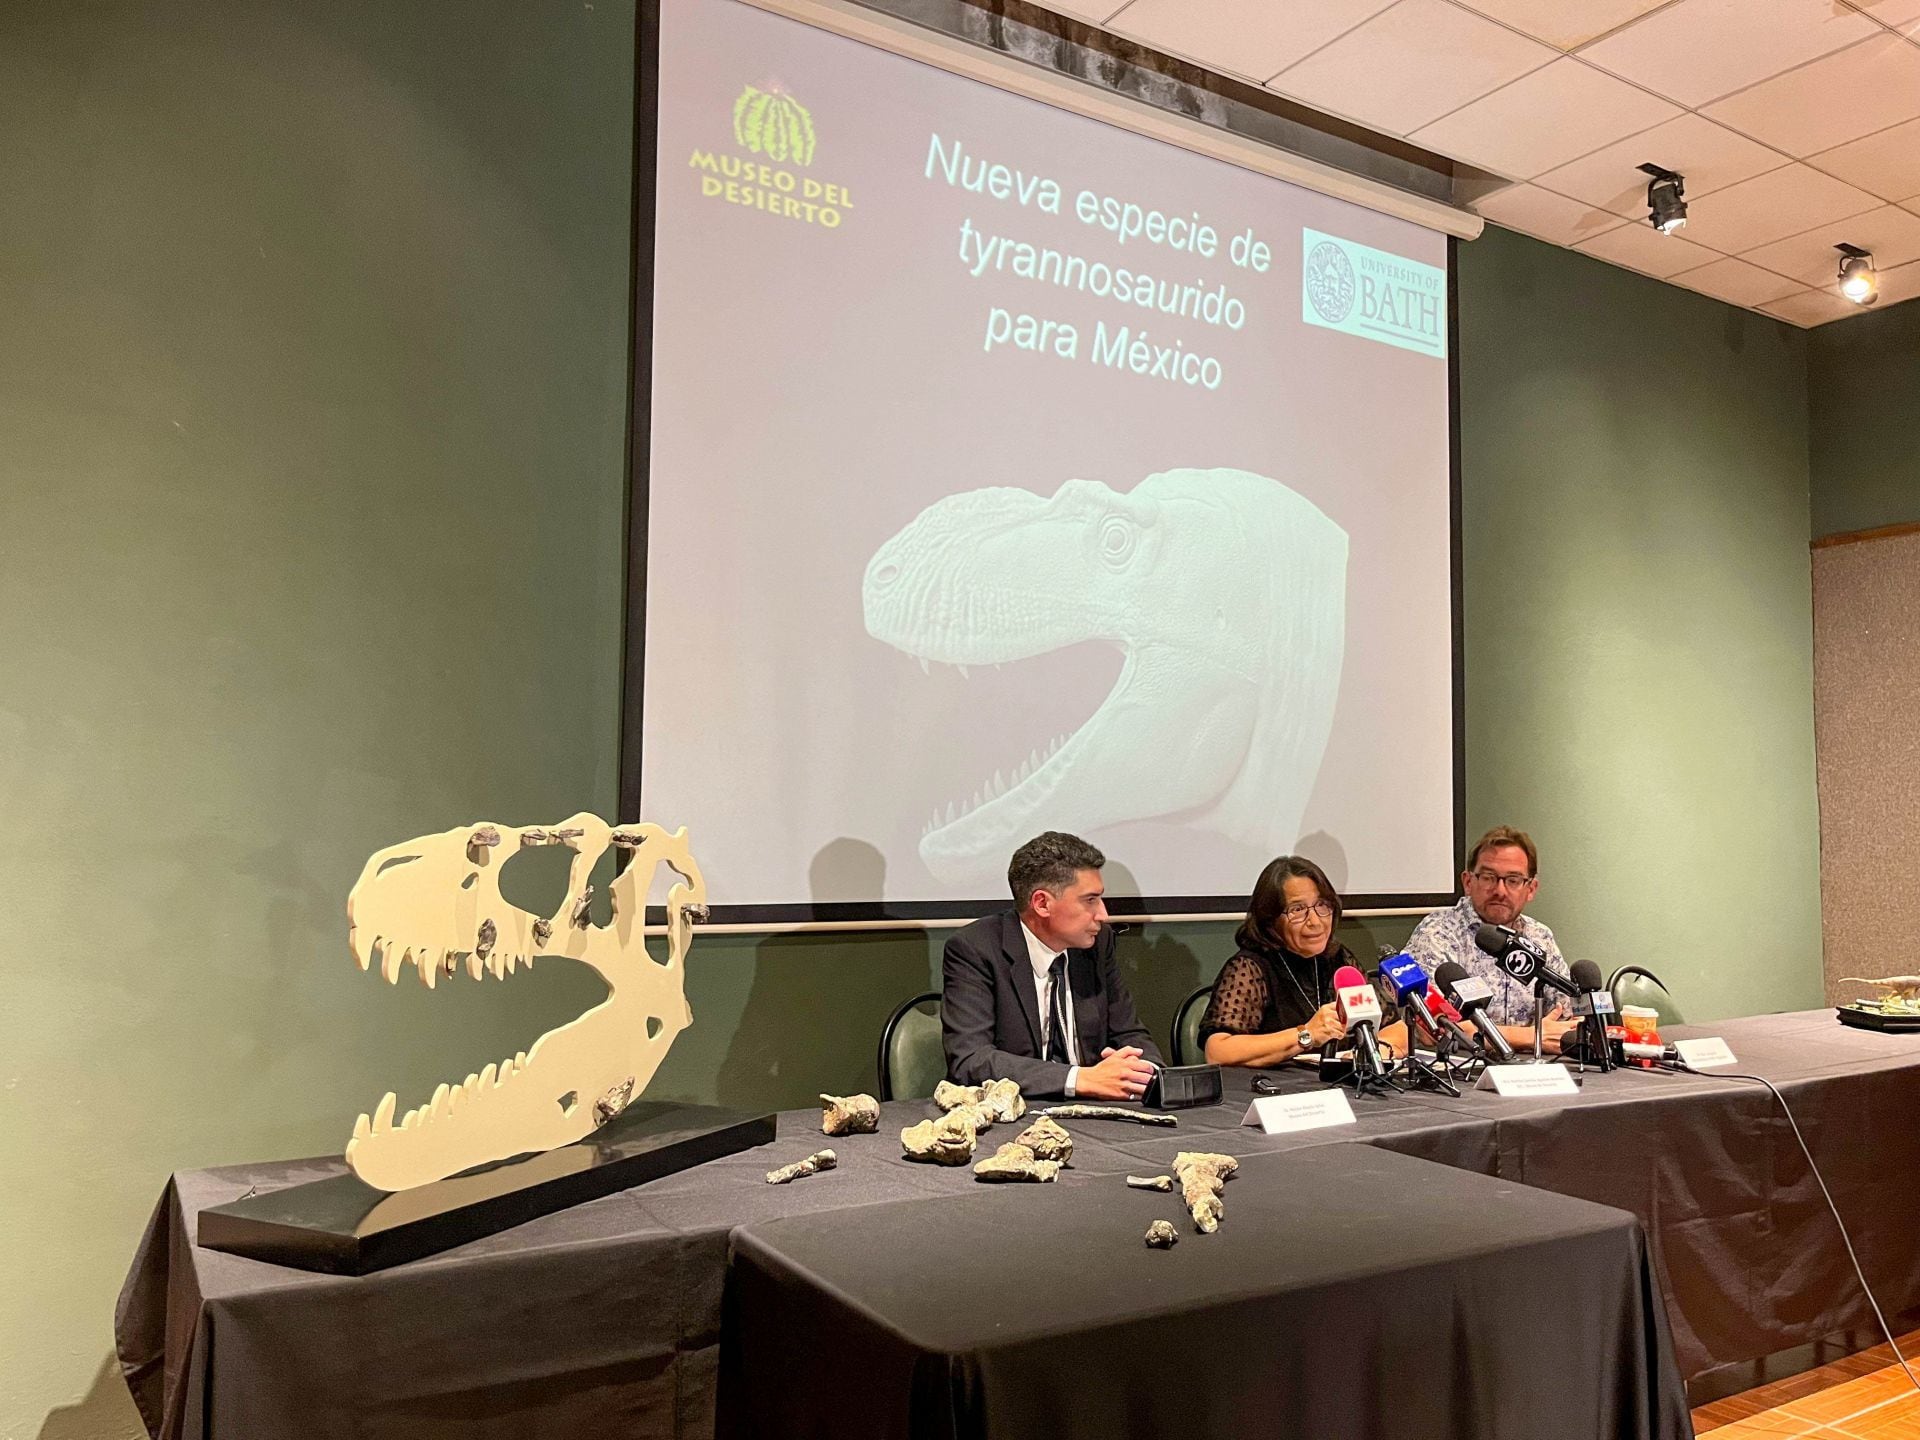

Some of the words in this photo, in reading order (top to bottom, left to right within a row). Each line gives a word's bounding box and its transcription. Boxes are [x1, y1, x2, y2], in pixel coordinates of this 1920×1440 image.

[689, 148, 796, 192] MUSEO
[803, 177, 854, 208] DEL
[702, 175, 841, 228] DESIERTO
[925, 132, 1061, 215] Nueva
[1076, 190, 1218, 258] especie
[1230, 228, 1271, 272] de
[959, 218, 1245, 330] tyrannosaurido
[1360, 256, 1422, 286] UNIVERSITY
[1425, 276, 1439, 290] OF
[1360, 274, 1440, 337] BATH
[983, 307, 1079, 359] para
[1091, 321, 1222, 389] México
